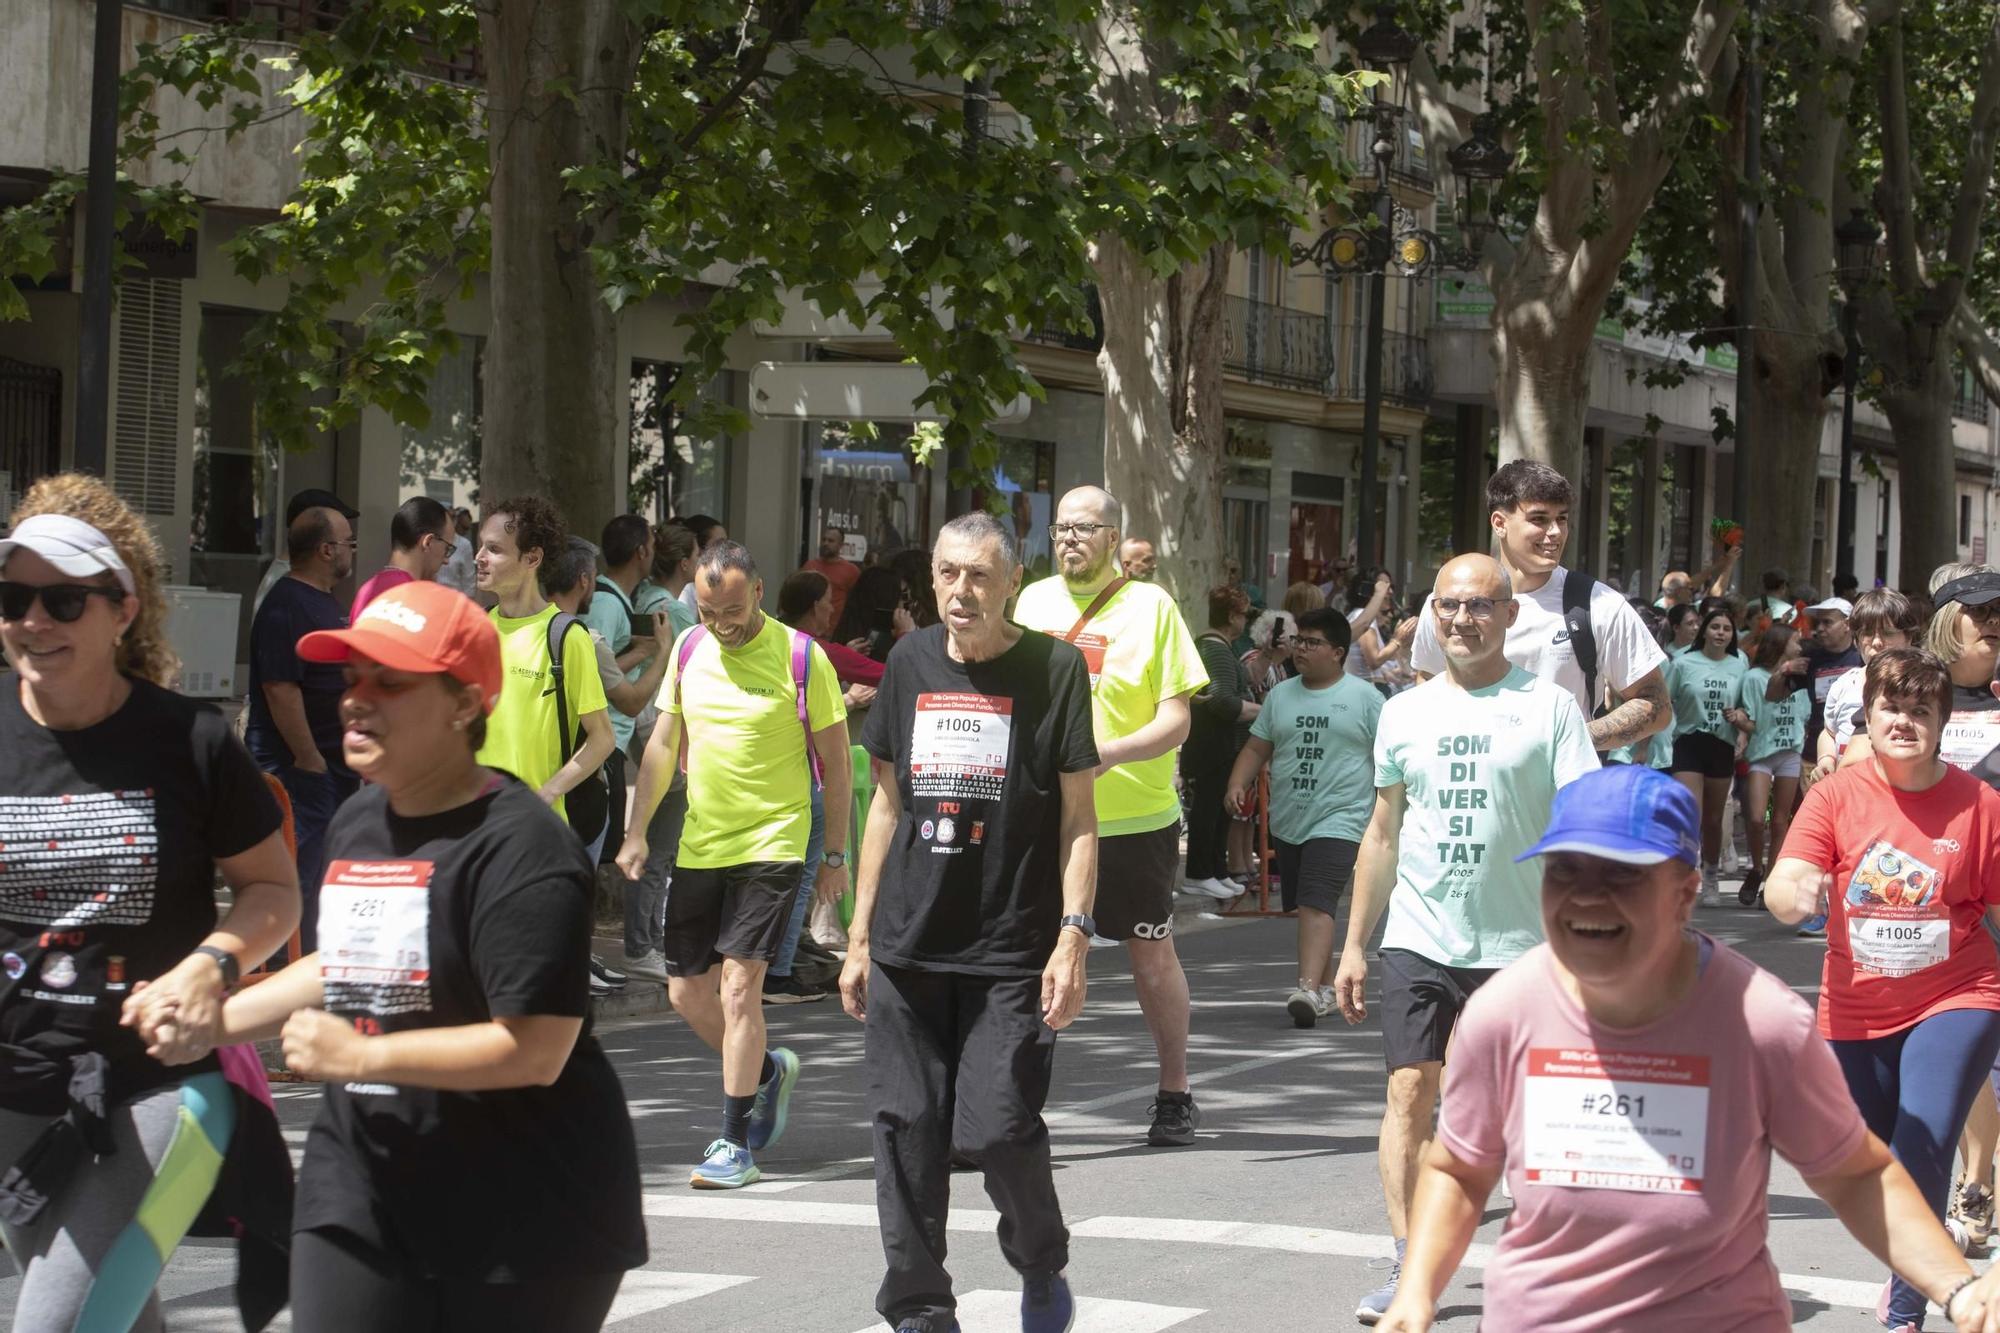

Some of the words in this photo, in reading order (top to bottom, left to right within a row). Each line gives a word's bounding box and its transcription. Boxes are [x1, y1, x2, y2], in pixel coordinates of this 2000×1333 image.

[1556, 630, 1570, 638] NIK
[1704, 680, 1727, 688] SOM
[1709, 690, 1720, 699] DI
[1703, 701, 1724, 710] VER
[1780, 706, 1790, 714] DI
[1296, 716, 1329, 729] SOM
[1708, 713, 1719, 721] SI
[1775, 717, 1794, 726] VER
[937, 718, 981, 733] #1005
[1303, 732, 1319, 744] DI
[1780, 728, 1789, 736] SI
[1437, 735, 1492, 756] SOM
[1774, 738, 1794, 748] TAT
[1296, 747, 1324, 760] VER
[939, 764, 995, 775] DIVERSITAT
[1299, 762, 1314, 775] SI
[1450, 762, 1476, 782] DI
[1292, 778, 1318, 790] TAT
[1438, 789, 1488, 809] VER
[1449, 816, 1473, 836] SI
[1437, 843, 1486, 864] TAT
[1448, 869, 1475, 877] 1005
[1450, 890, 1469, 898] 261
[1134, 914, 1172, 939] ad
[1876, 926, 1922, 940] #1005
[1615, 1054, 1651, 1065] Popular
[1646, 1068, 1692, 1080] Funcional
[1582, 1093, 1645, 1118] #261
[1578, 1171, 1682, 1191] DIVERSITAT
